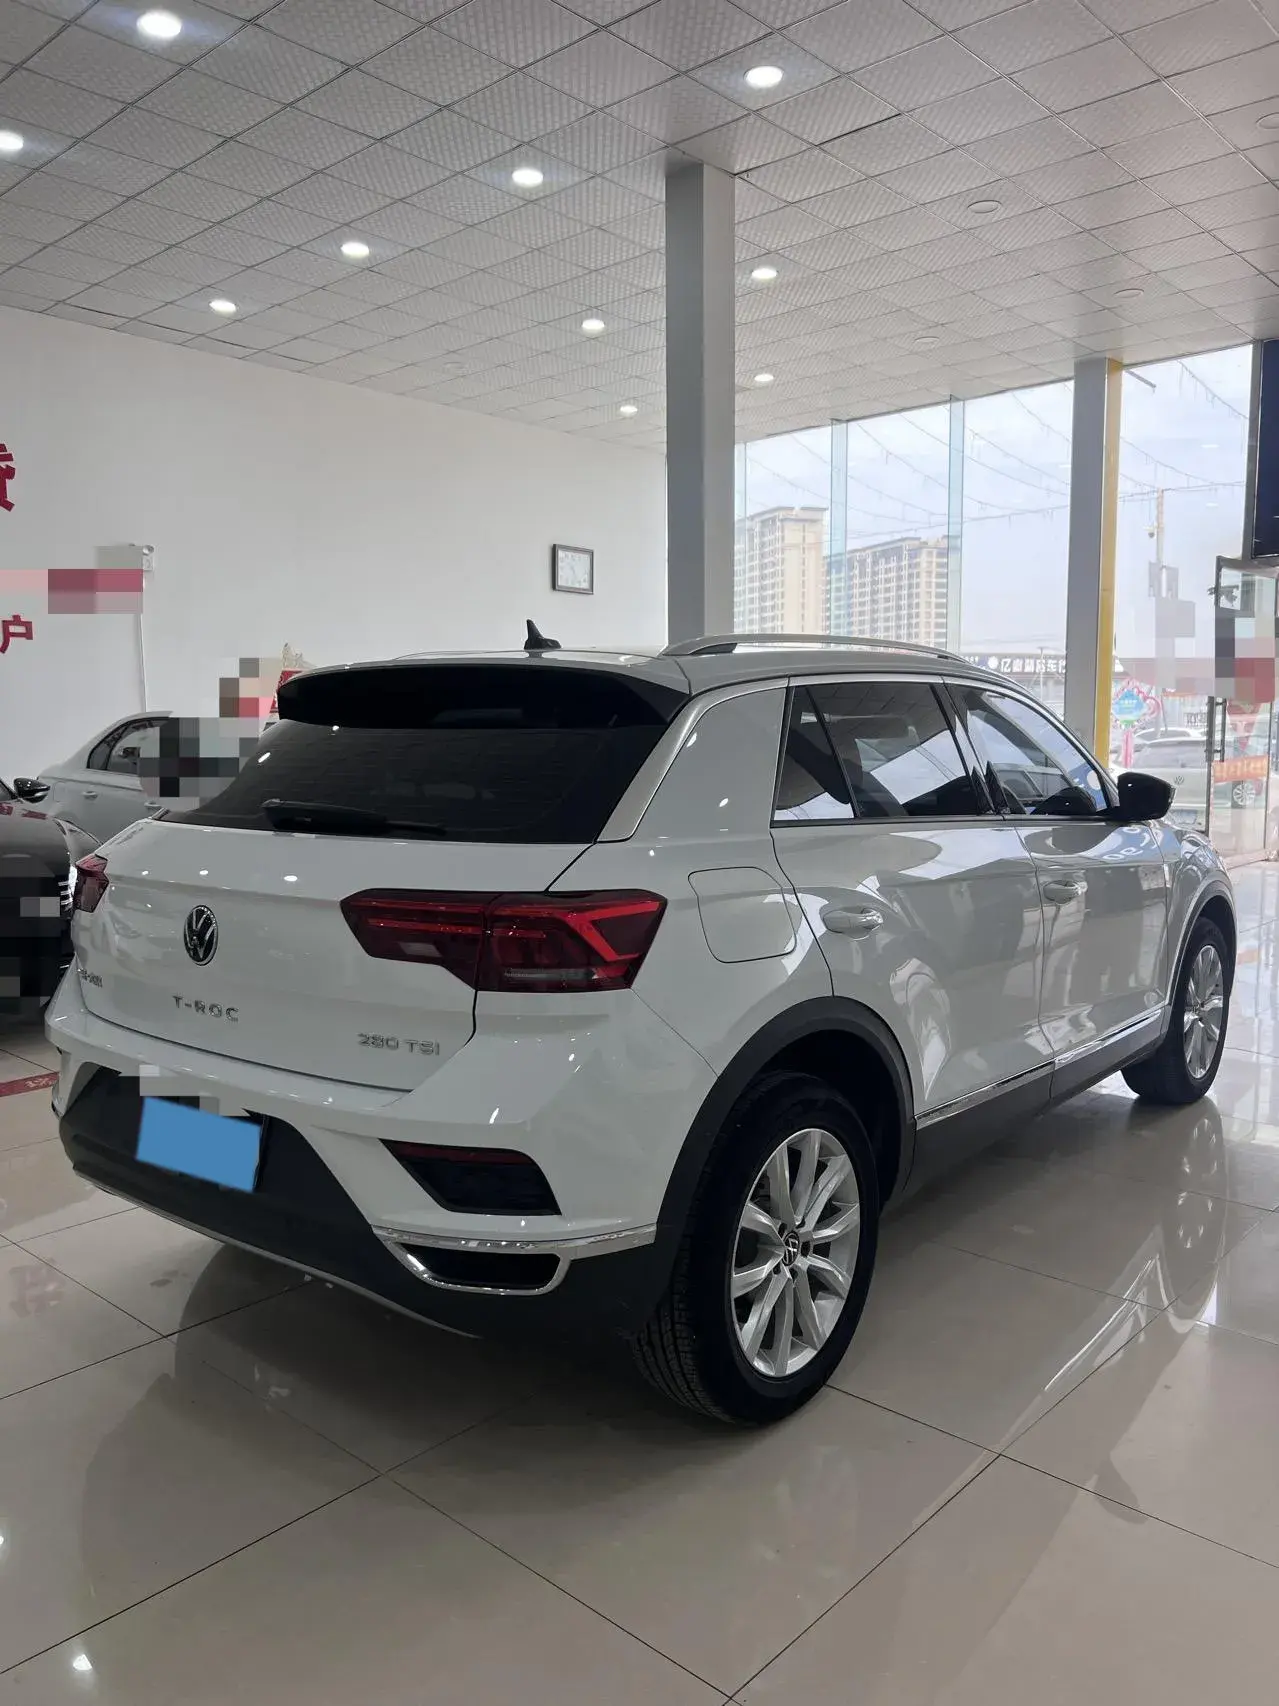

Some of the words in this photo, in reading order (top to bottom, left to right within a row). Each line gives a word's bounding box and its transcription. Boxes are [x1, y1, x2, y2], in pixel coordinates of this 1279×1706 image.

[1, 615, 33, 654] 户
[172, 994, 239, 1022] T-ROC
[358, 1033, 399, 1051] 280
[404, 1039, 440, 1056] TSI
